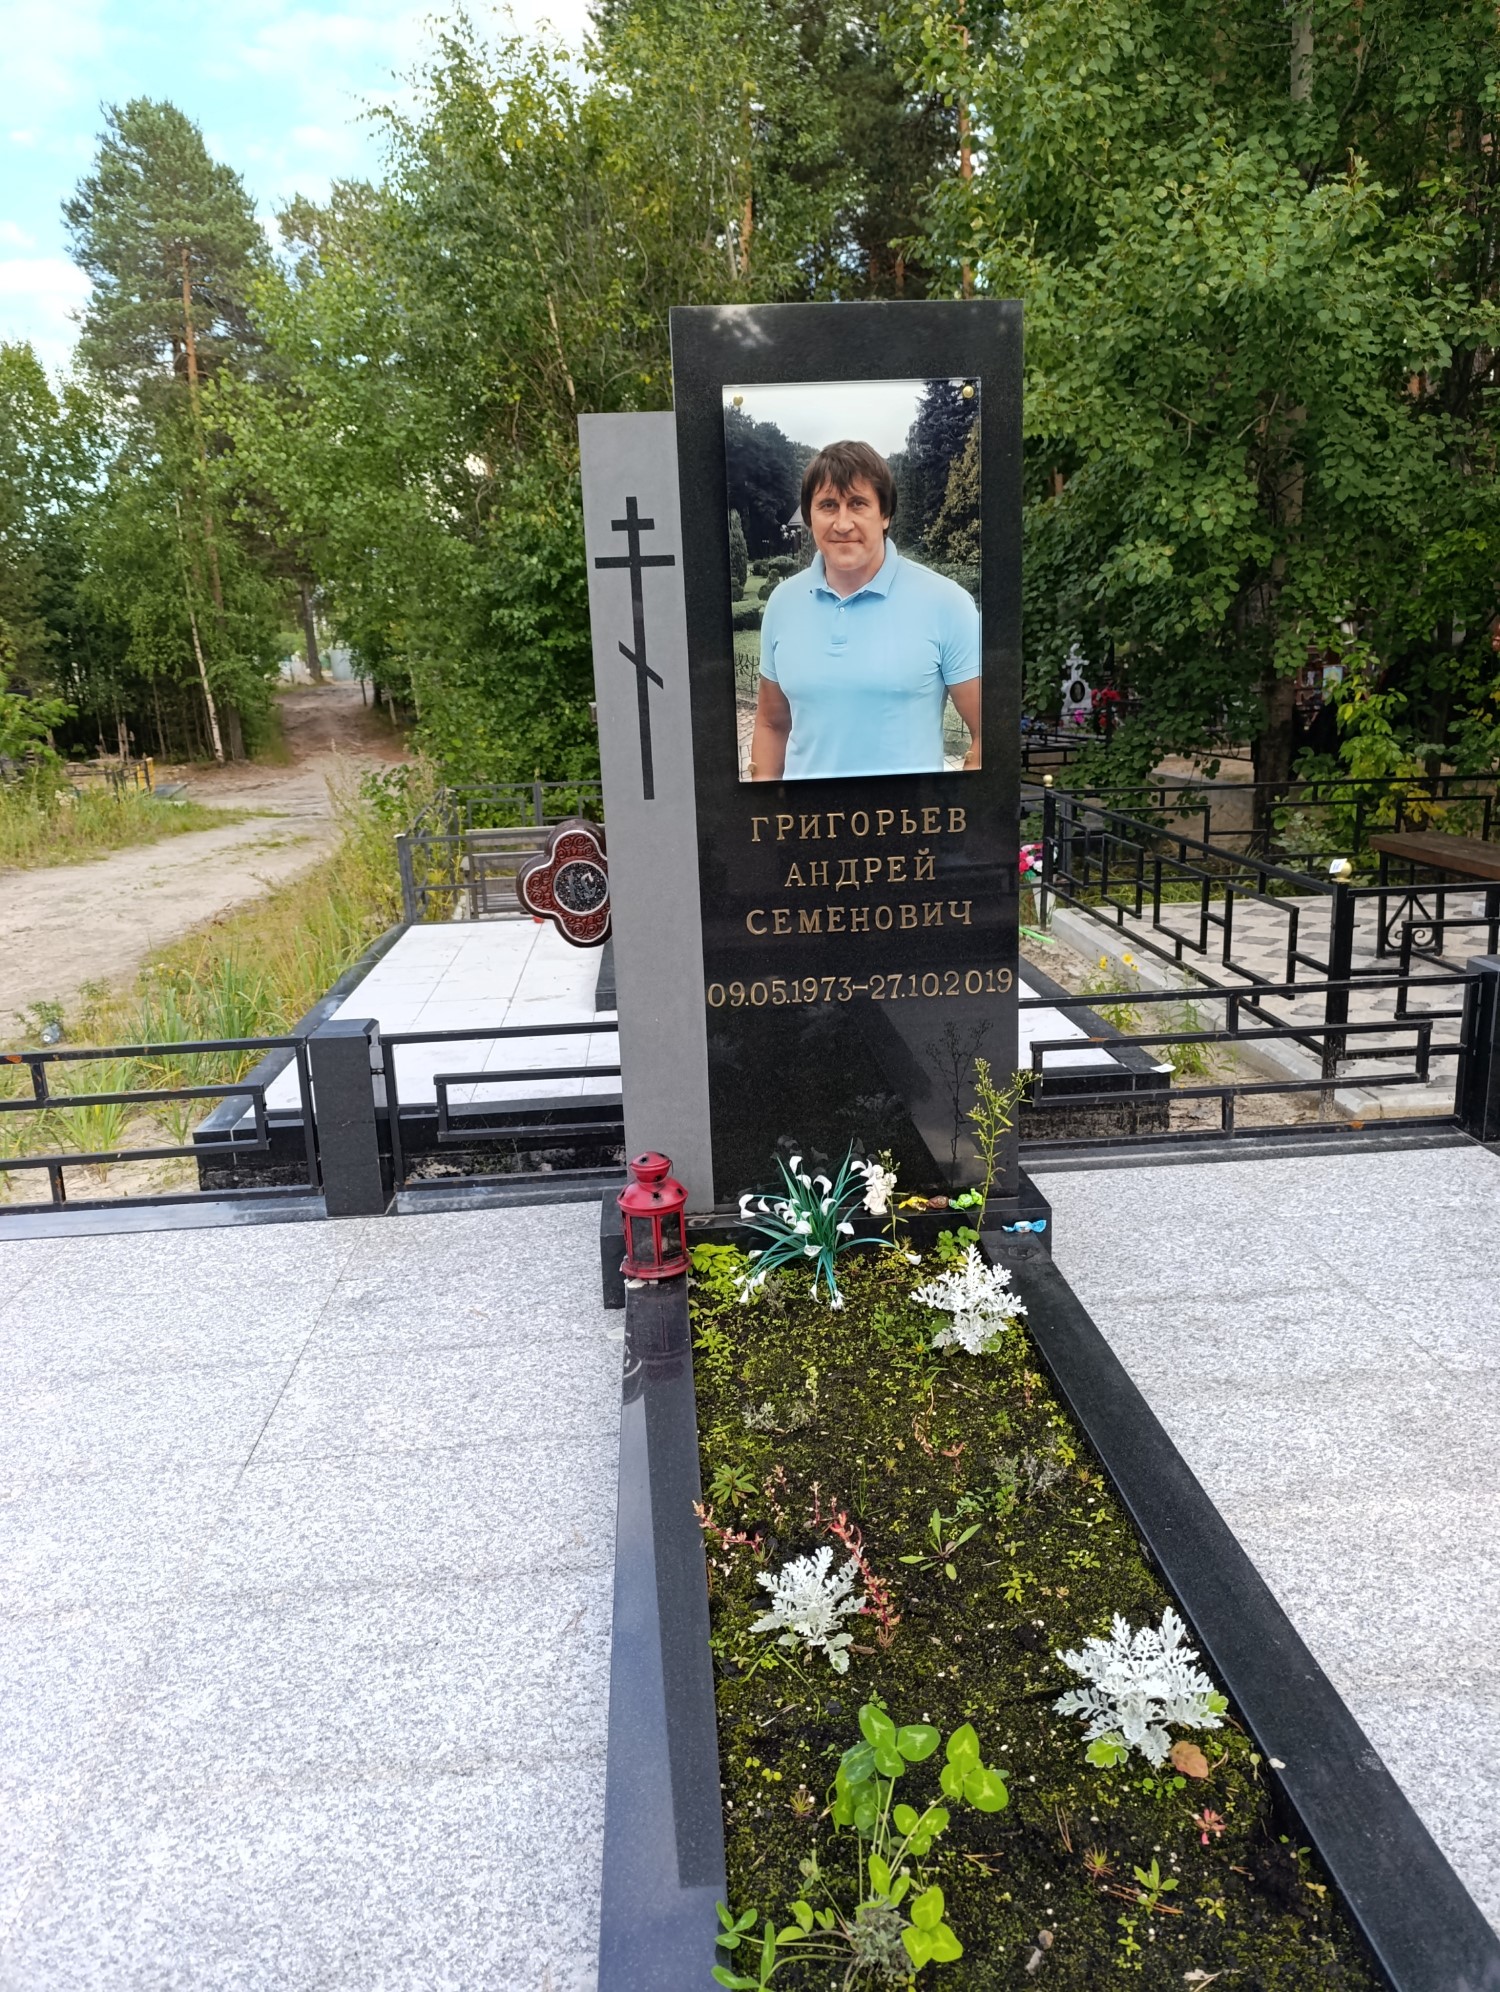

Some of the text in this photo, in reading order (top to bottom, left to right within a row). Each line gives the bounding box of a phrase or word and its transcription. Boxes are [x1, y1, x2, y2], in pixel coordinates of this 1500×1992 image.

[751, 807, 967, 842] ГРИГОРЬЕВ
[784, 847, 936, 891] АНДРЕЙ
[746, 901, 972, 935] СЕМЕНОВИЧ
